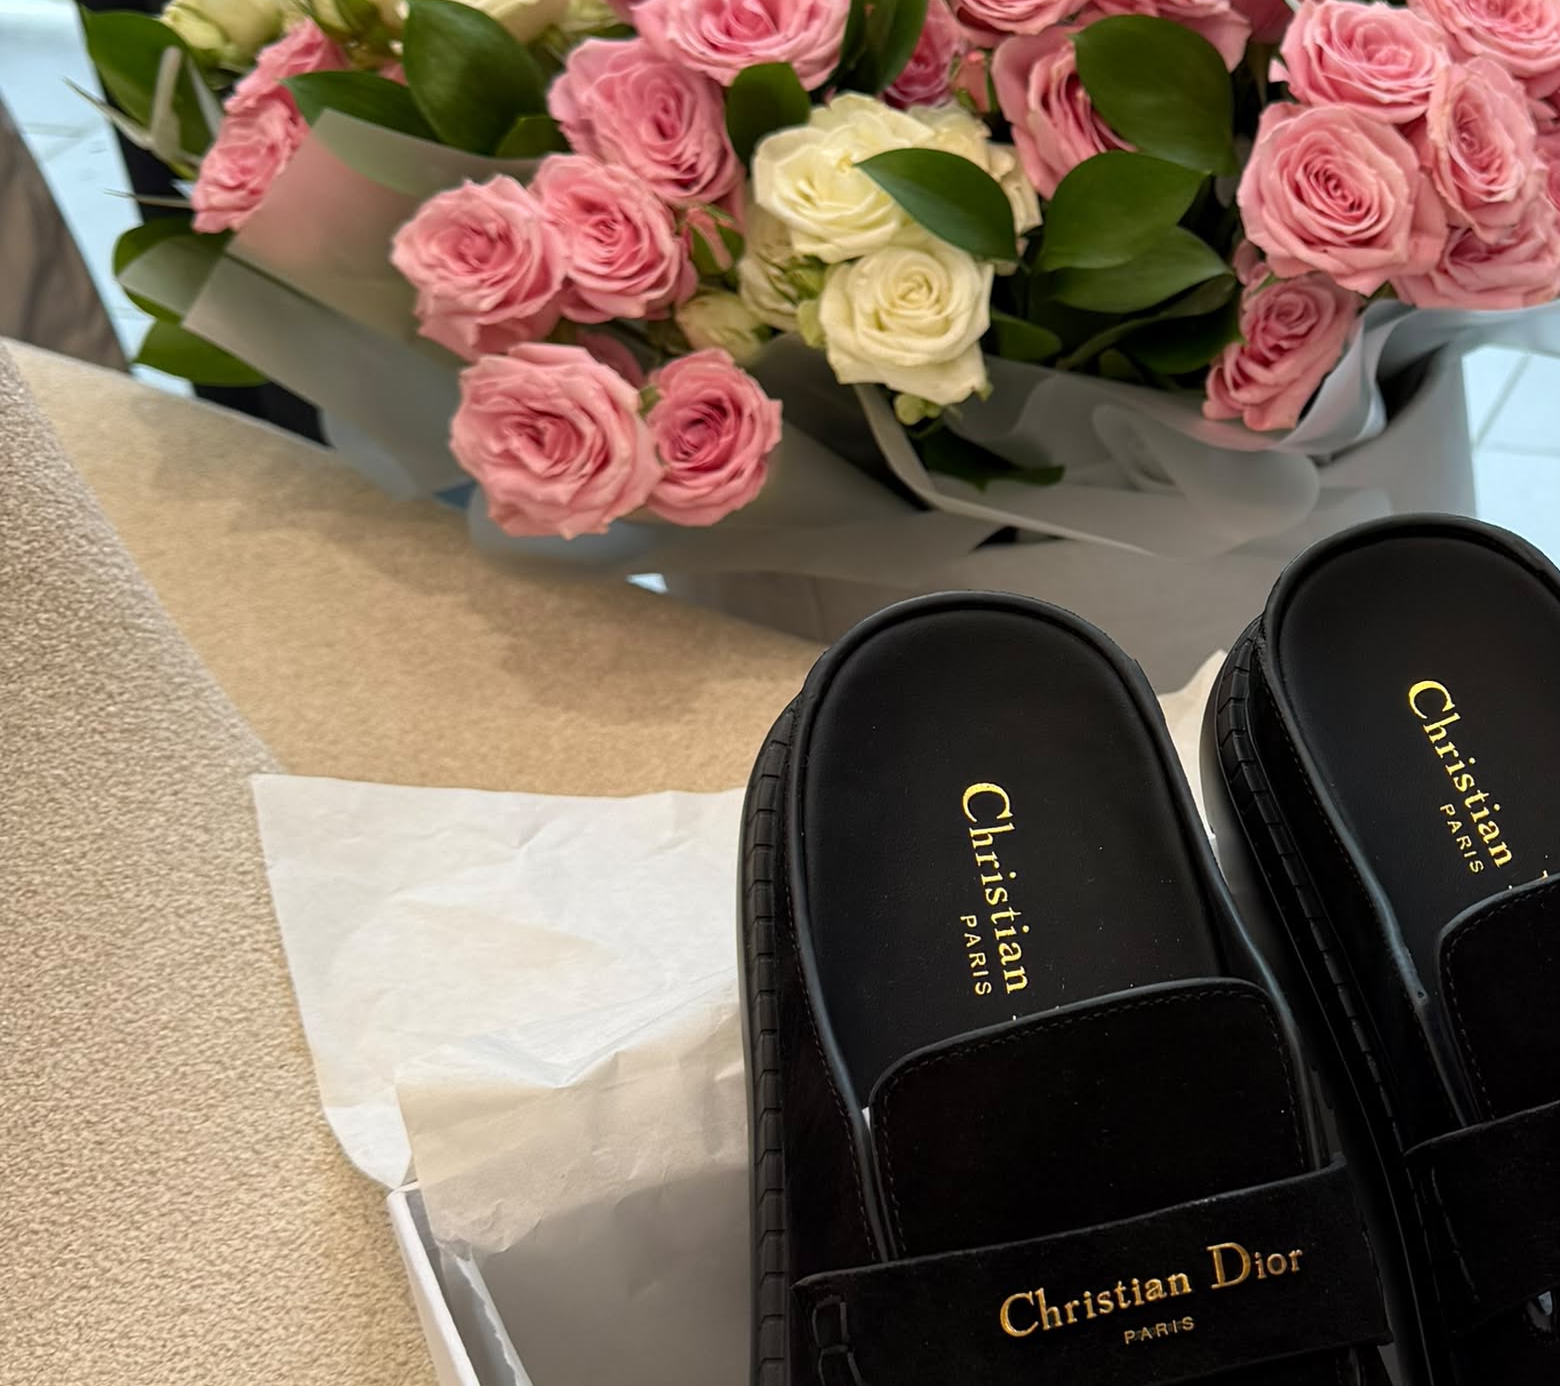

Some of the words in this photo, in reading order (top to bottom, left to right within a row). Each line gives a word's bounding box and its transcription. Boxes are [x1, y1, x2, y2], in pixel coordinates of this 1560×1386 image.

[1405, 679, 1513, 868] Christian
[1439, 804, 1485, 875] PARIS
[961, 781, 1029, 996] Christian
[959, 914, 992, 998] PARIS
[999, 1270, 1193, 1338] Christian
[1205, 1241, 1303, 1291] Dior
[1123, 1316, 1196, 1346] PARIS
